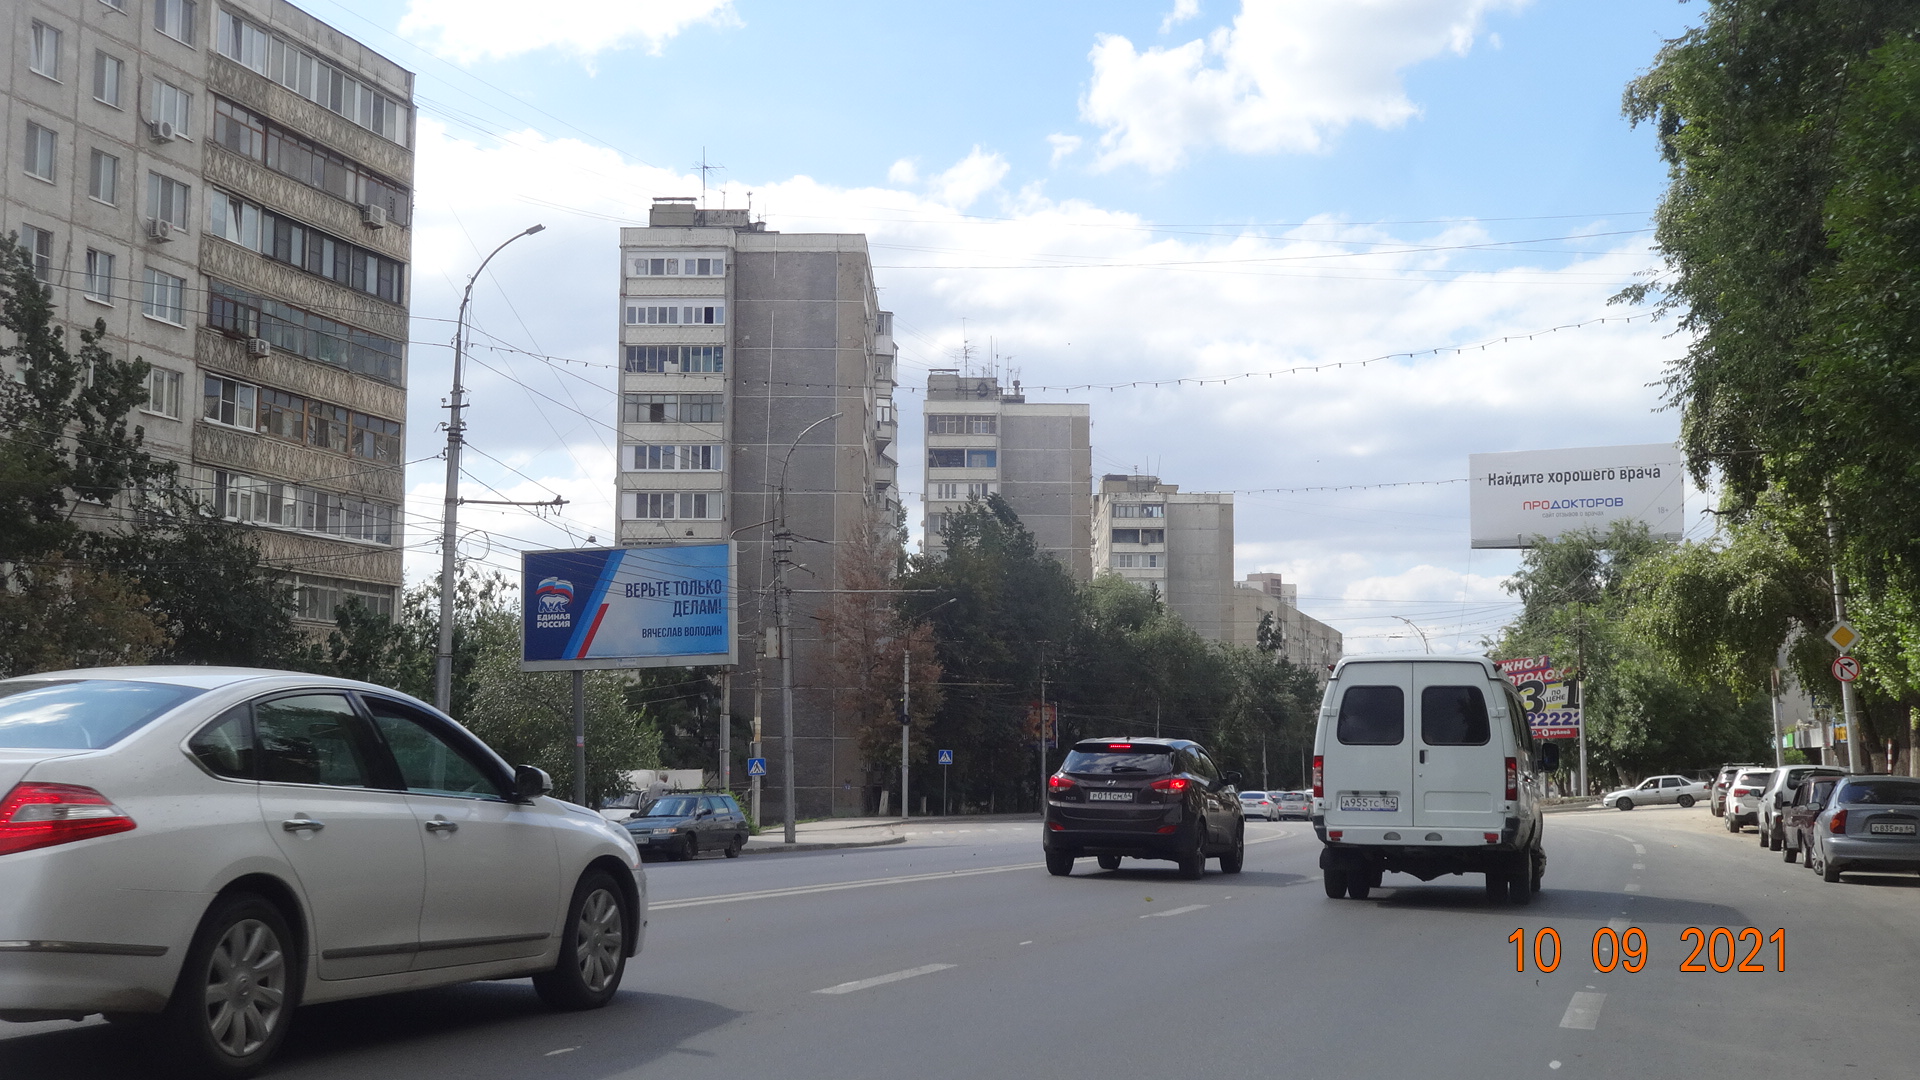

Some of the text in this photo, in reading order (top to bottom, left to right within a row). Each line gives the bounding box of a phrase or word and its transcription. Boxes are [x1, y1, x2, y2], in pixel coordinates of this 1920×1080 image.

[1488, 467, 1661, 487] Найдите хорошего врача
[1523, 497, 1624, 511] ПРОДОКТОРОВ
[1584, 510, 1604, 518] врачах
[625, 579, 722, 599] ВЕРЬТЕ ТОЛЬКО
[672, 599, 722, 618] ДЕЛАМ!
[537, 613, 571, 622] ЕДИНАЯ
[537, 620, 571, 629] РОССИЯ
[642, 625, 723, 639] ВЯЧЕСЛАВ ВОЛОДИН
